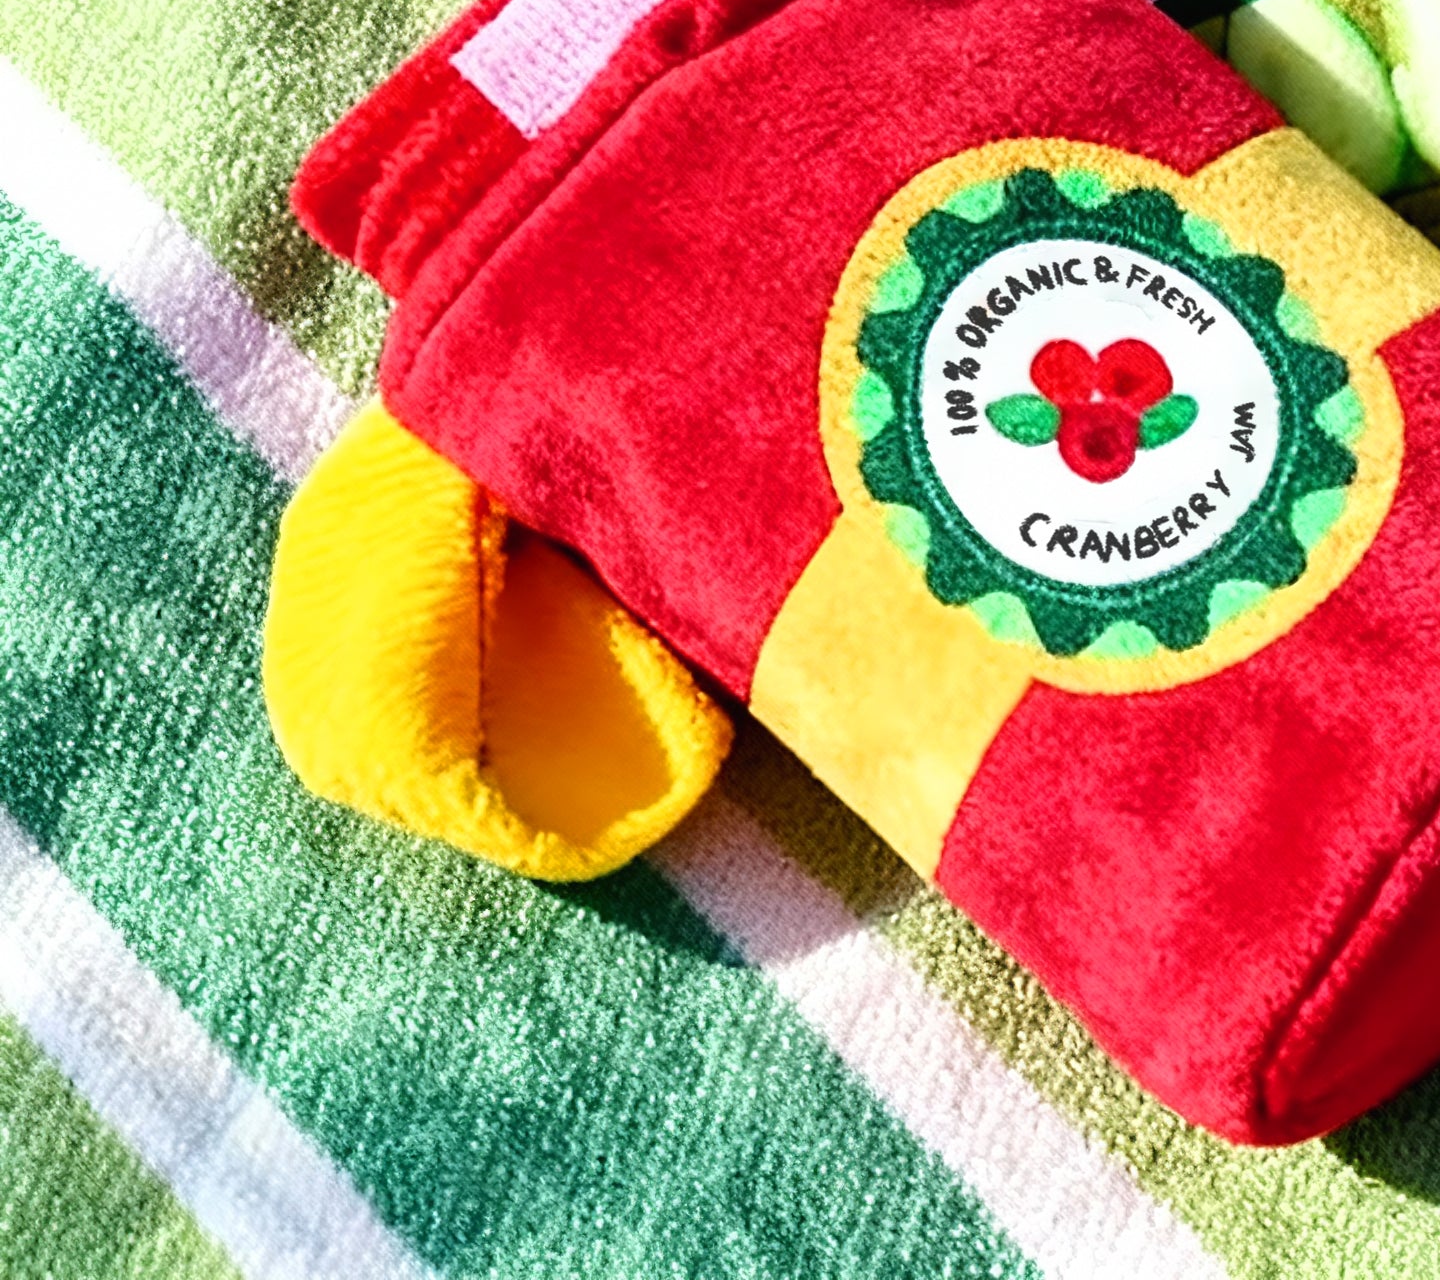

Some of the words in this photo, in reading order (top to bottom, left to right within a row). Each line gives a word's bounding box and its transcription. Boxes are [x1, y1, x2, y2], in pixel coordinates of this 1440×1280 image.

[955, 257, 1088, 349] ORGANIC
[1093, 255, 1120, 283] &
[1125, 263, 1216, 335] FRESH
[1018, 469, 1231, 563] CRANBERRY
[1229, 401, 1257, 463] JAM
